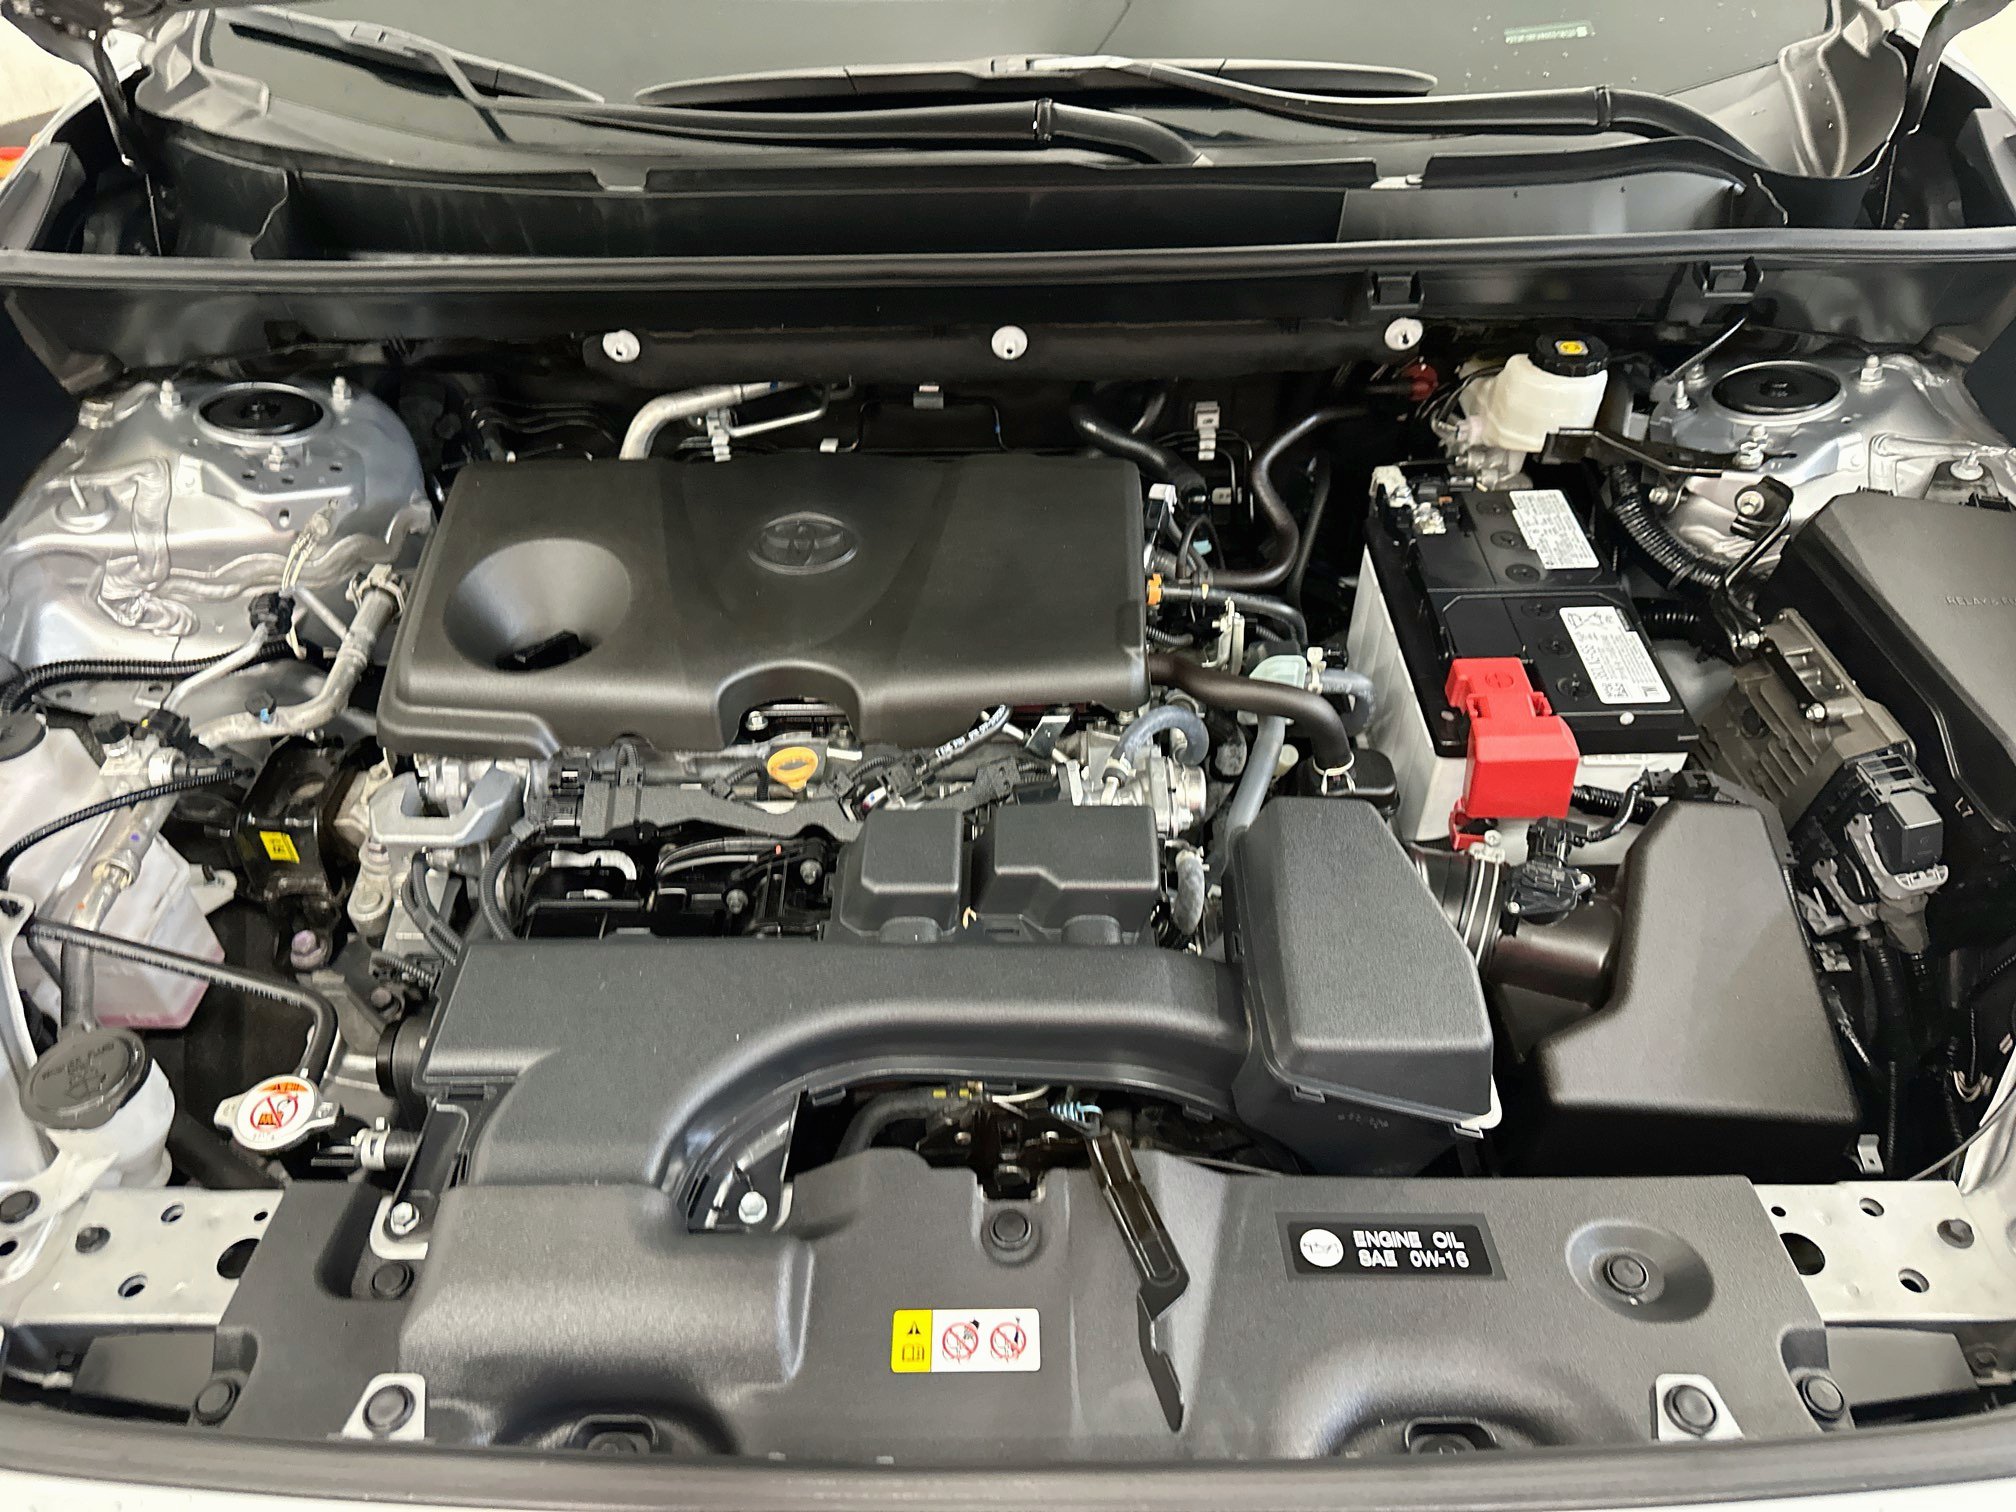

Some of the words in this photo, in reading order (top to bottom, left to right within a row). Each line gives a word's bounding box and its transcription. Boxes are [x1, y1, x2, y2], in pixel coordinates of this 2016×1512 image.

[1353, 1230, 1422, 1248] ENGINE
[1432, 1231, 1465, 1248] OIL
[1358, 1249, 1398, 1267] SAE
[1409, 1250, 1470, 1268] 0W-16
